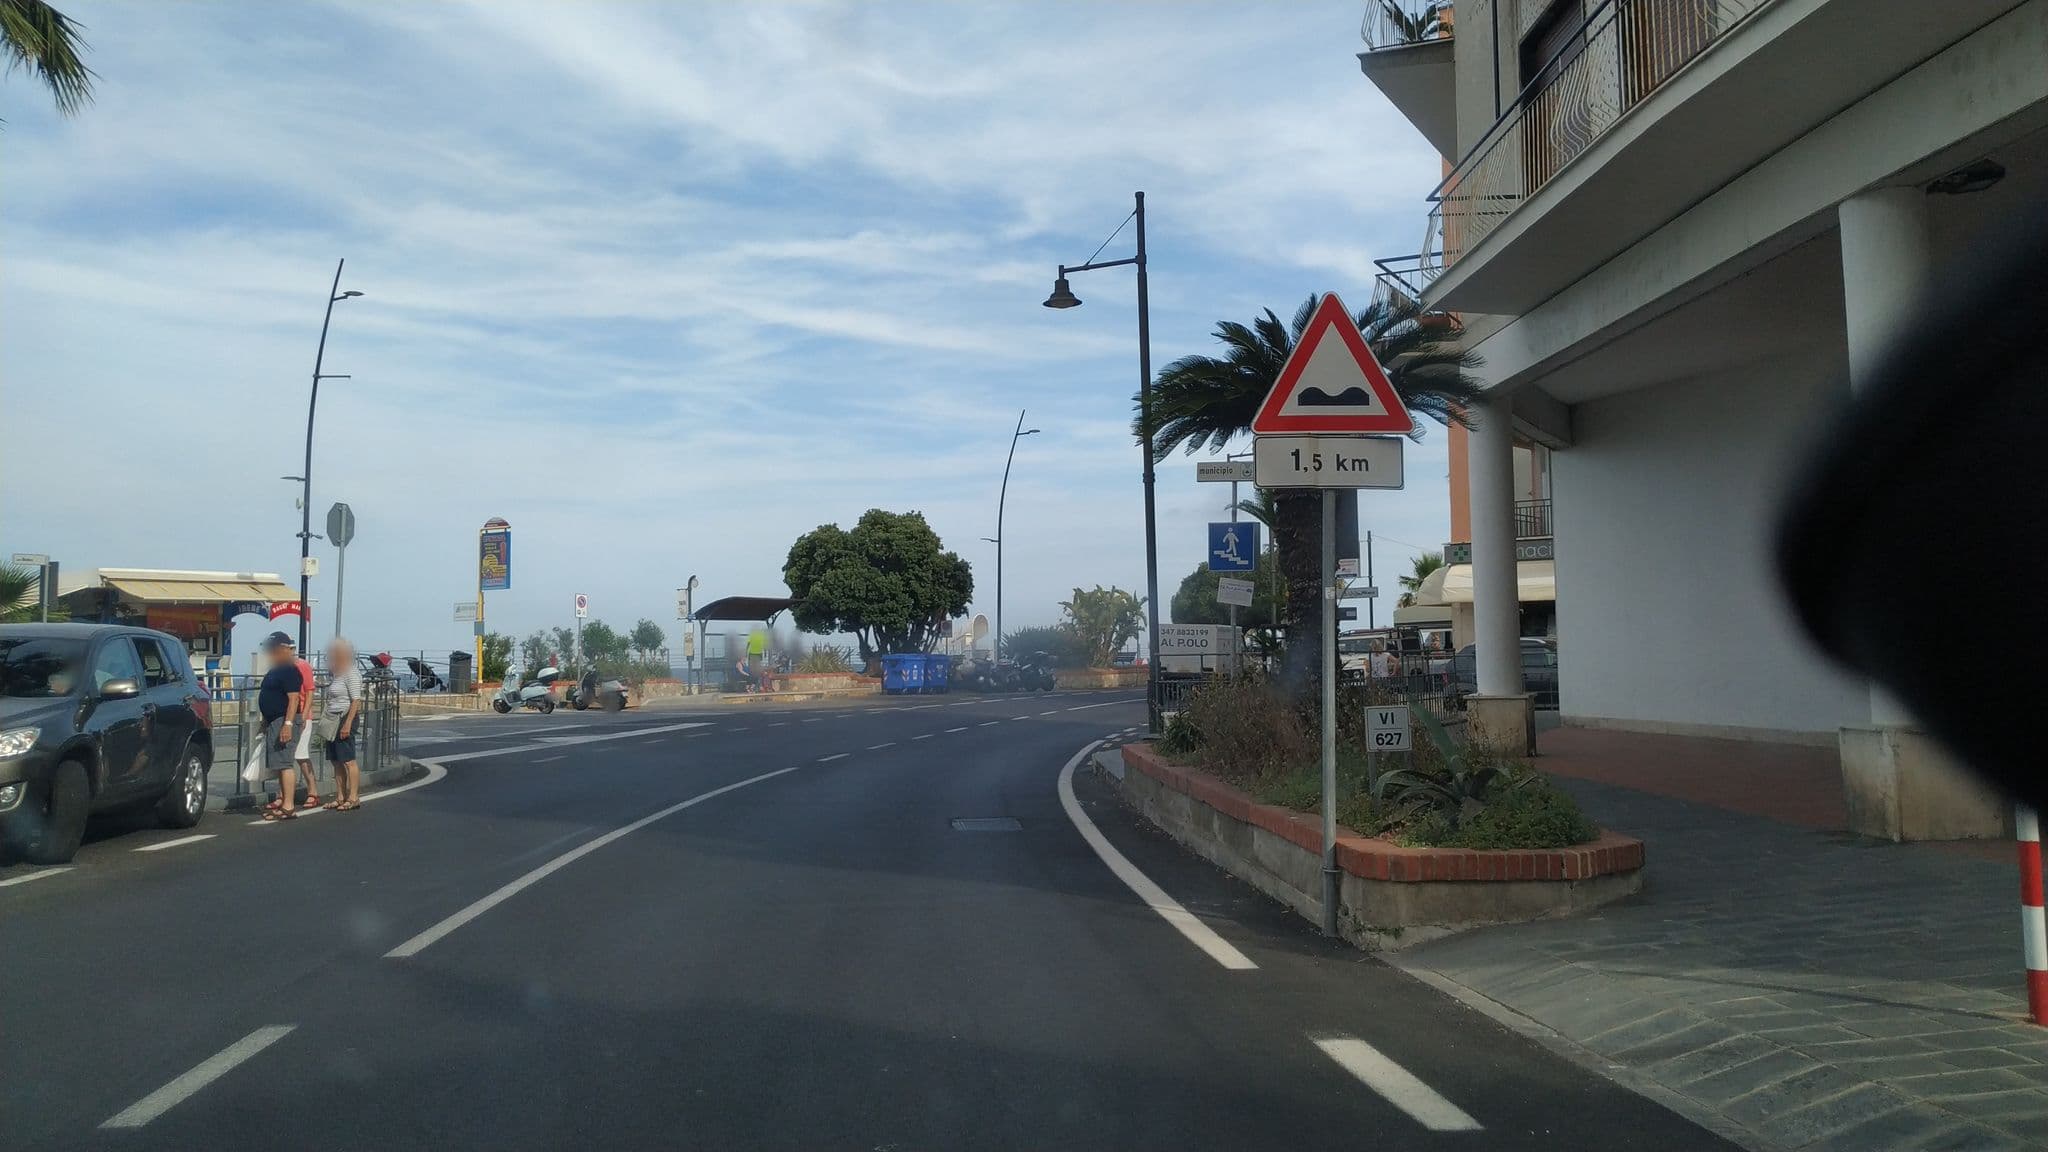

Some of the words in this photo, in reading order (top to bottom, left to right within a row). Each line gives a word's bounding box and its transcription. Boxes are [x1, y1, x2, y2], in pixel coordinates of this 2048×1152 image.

[1290, 448, 1323, 473] 1,5
[1336, 453, 1369, 472] km
[1199, 466, 1233, 476] municipio
[1160, 638, 1174, 647] AL
[1379, 712, 1395, 724] VI
[1375, 732, 1402, 746] 627
